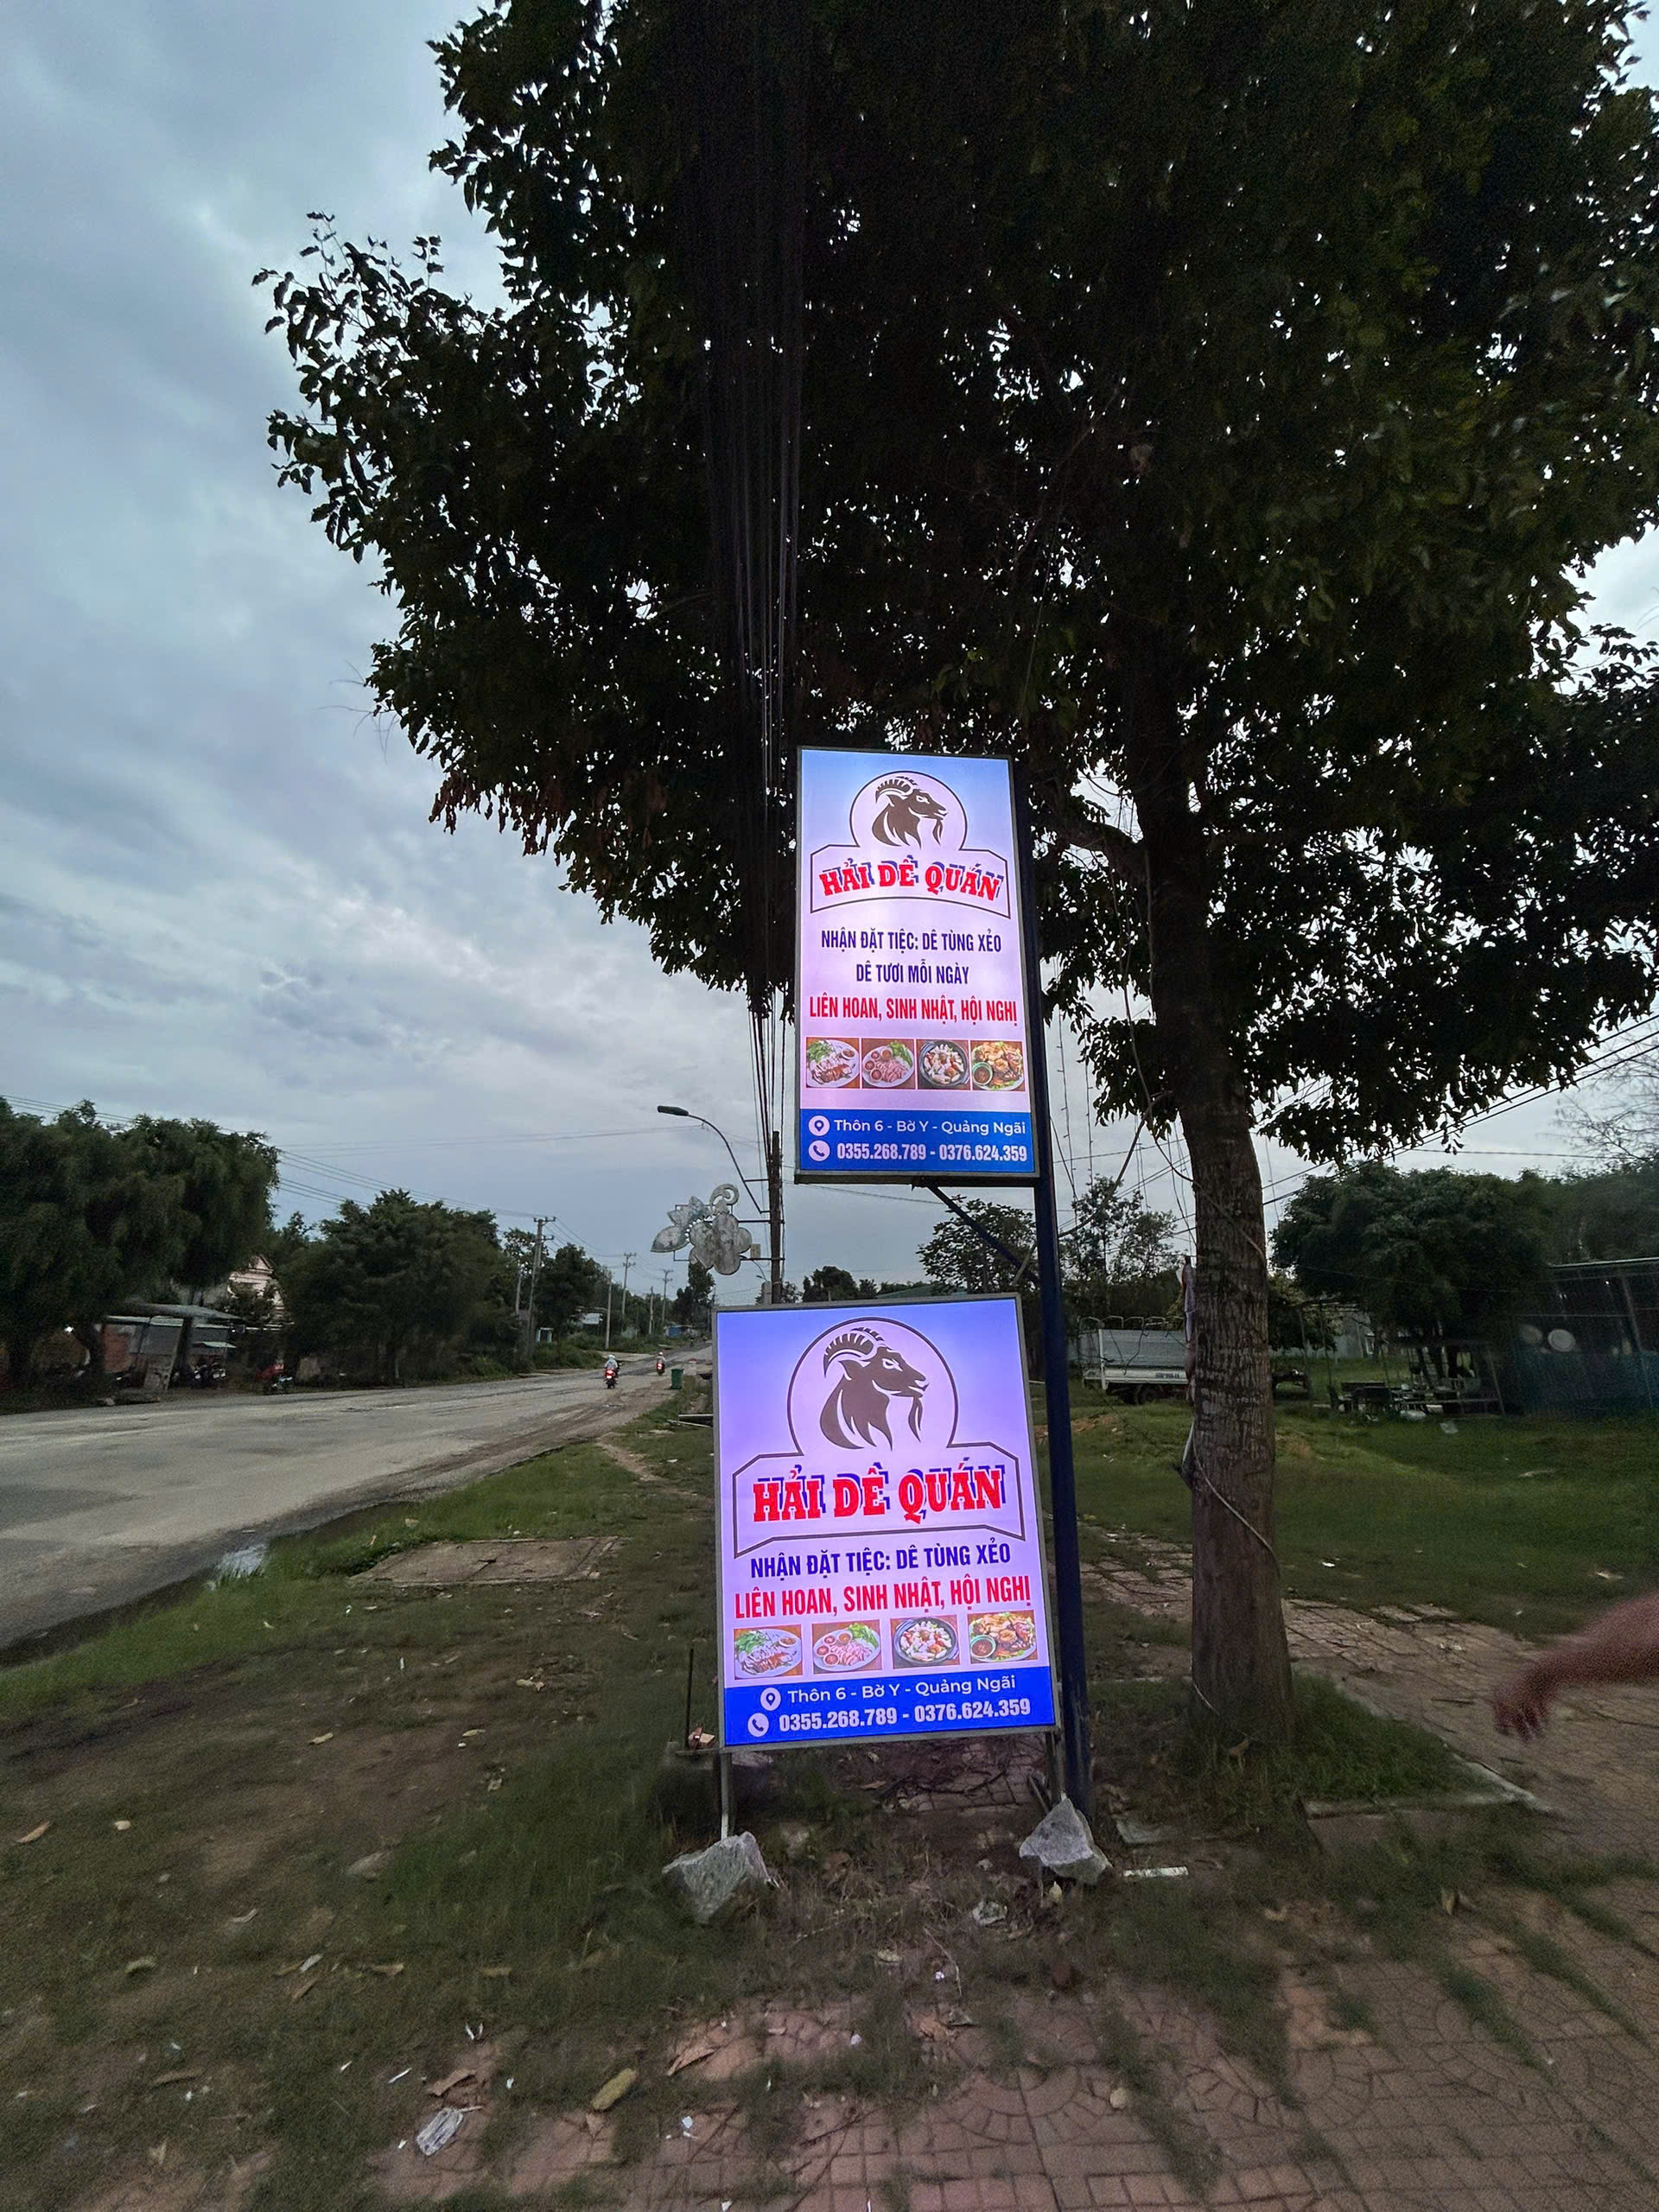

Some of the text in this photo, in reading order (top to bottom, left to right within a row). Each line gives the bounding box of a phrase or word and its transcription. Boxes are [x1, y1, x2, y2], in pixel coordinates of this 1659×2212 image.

[819, 855, 1004, 900] HẢI DÊ QUÁN
[822, 926, 1001, 953] NHẬN ĐẶT TIỆC: DÊ TÙNG XẺO
[856, 959, 969, 984] DÊ TƯƠI MỖI NGÀY
[810, 992, 1017, 1026] LIÊN HOAN, SINH NHẬT, HỘI NGHỊ
[834, 1119, 870, 1131] Thôn
[875, 1120, 883, 1132] 6
[897, 1120, 916, 1132] Bờ
[918, 1121, 928, 1132] Y
[942, 1120, 988, 1135] Quảng
[994, 1122, 1026, 1135] Ngãi
[837, 1143, 926, 1160] 0355.268.789
[939, 1144, 1027, 1161] 0376.624.359
[753, 1457, 1005, 1524] HẢI DÊ QUÁN
[751, 1537, 1011, 1580] NHẬN ĐẶT TIỆC: DÊ TÙNG XẺO
[734, 1573, 1031, 1618] LIÊN HOAN, SINH NHẬT, HỘI NGHỊ
[788, 1688, 830, 1704] Thôn
[836, 1688, 845, 1700] 6
[862, 1684, 885, 1699] Bờ
[888, 1684, 900, 1696] Y
[915, 1678, 972, 1695] Quảng
[976, 1675, 1016, 1692] Ngãi
[779, 1707, 898, 1732] 0355.268.789
[914, 1698, 1031, 1724] 0376.624.359
